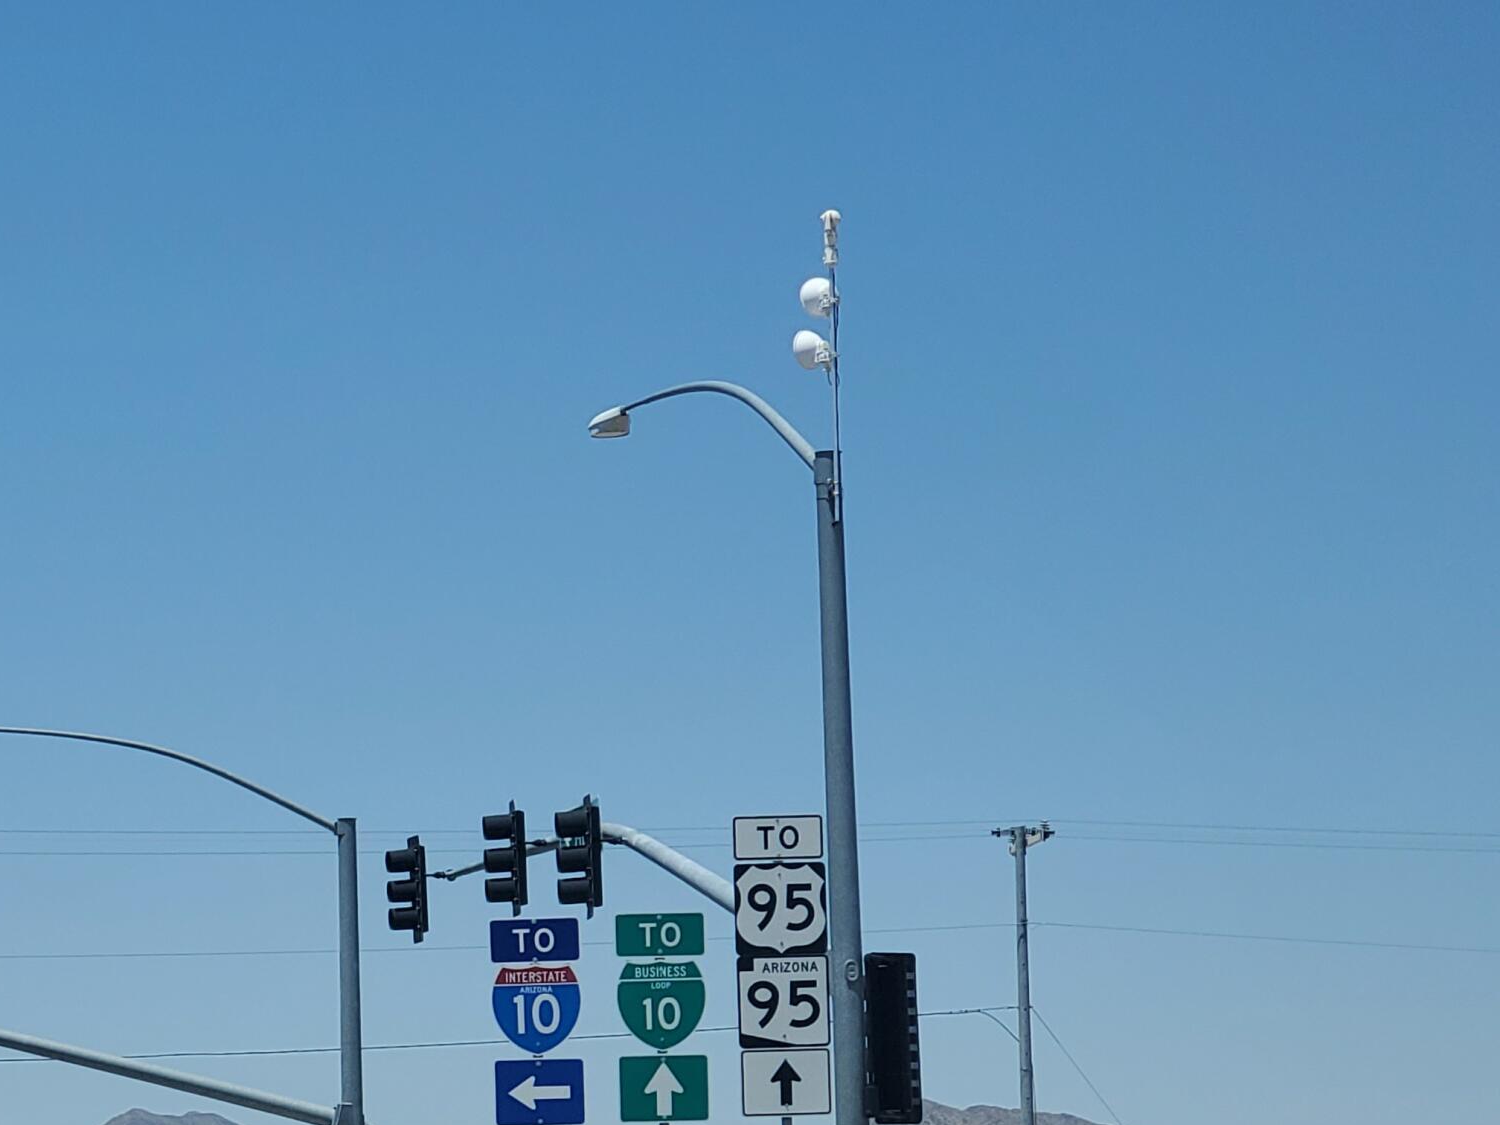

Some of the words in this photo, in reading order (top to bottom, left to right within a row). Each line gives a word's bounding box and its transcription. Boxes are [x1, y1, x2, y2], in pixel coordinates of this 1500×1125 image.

[756, 826, 800, 850] TO
[746, 883, 816, 931] 95
[512, 928, 555, 953] TO
[639, 923, 682, 948] TO
[505, 970, 567, 983] INTERSTATE
[633, 965, 687, 978] BUSINESS
[761, 961, 819, 974] ARIZONA
[512, 993, 561, 1035] 10
[641, 997, 682, 1032] 10
[746, 980, 820, 1029] 95
